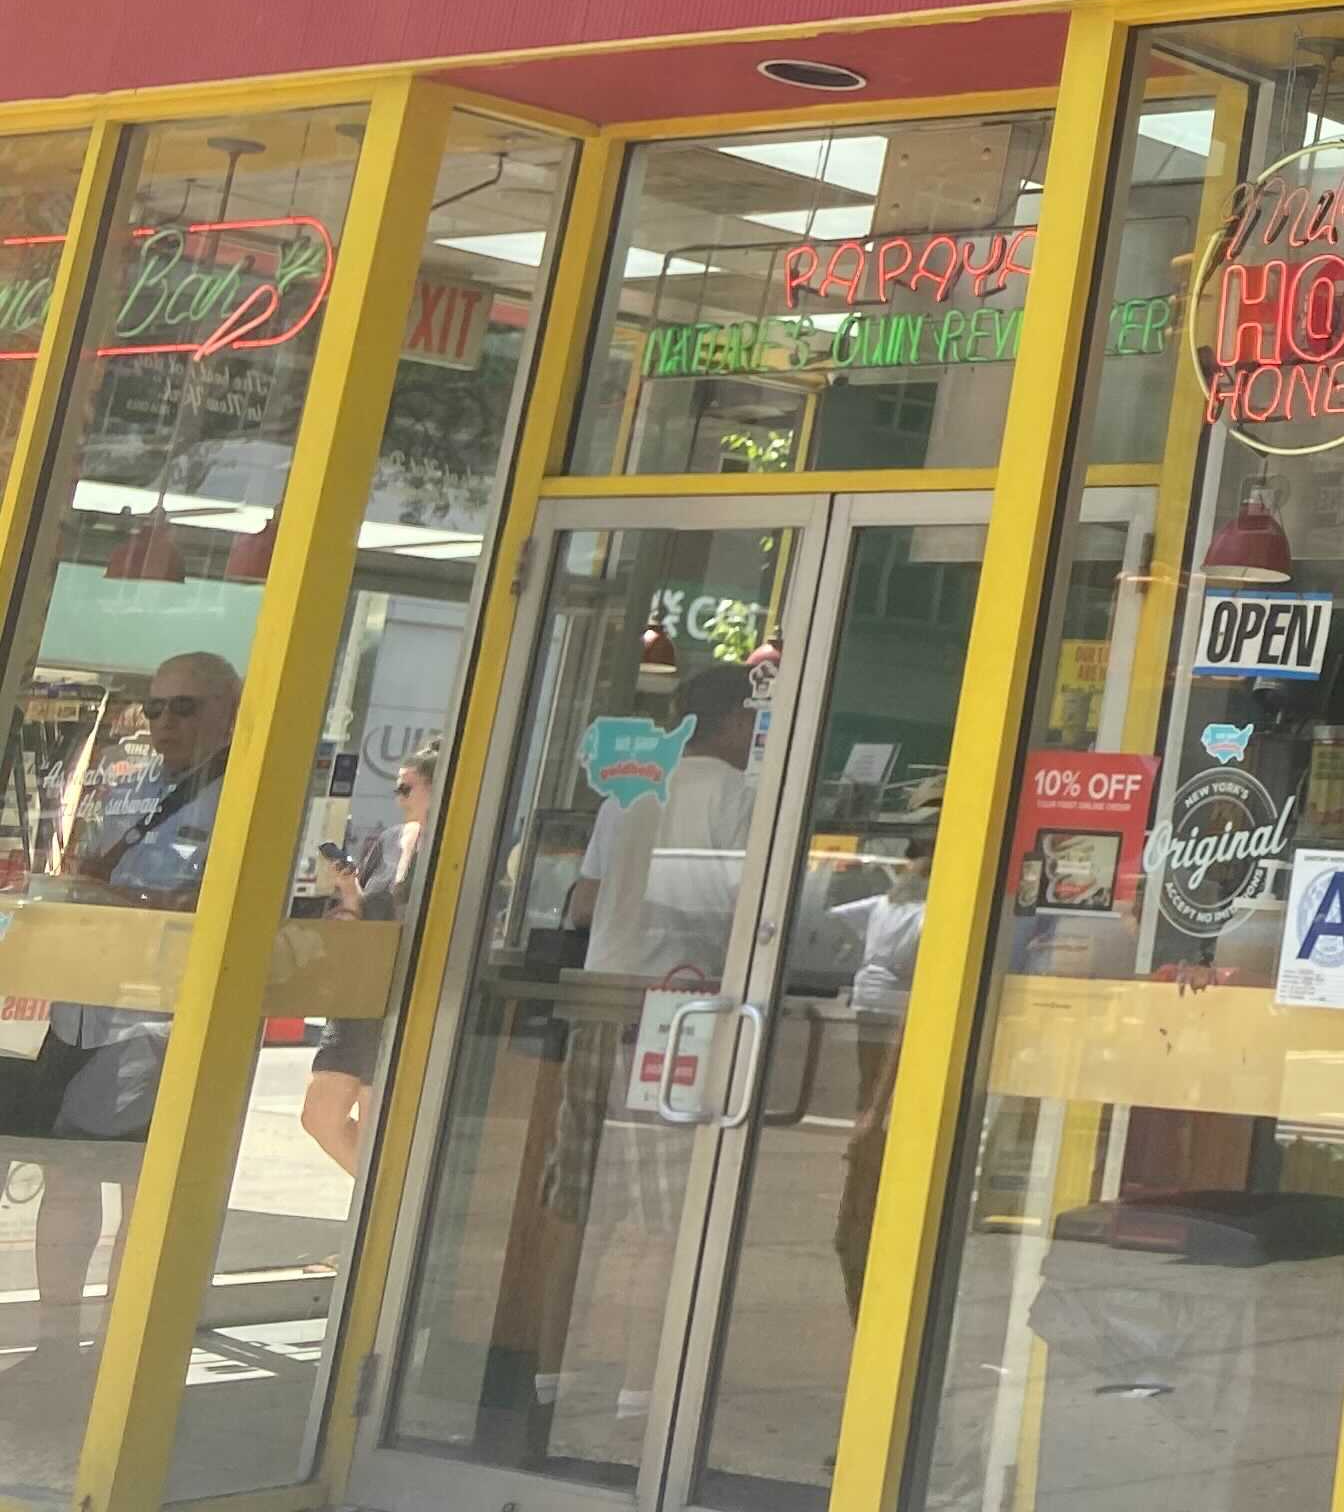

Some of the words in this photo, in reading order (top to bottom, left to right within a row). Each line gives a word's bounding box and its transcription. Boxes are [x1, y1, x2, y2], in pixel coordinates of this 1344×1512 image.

[408, 286, 483, 359] XIT
[831, 313, 929, 368] OWN
[1206, 600, 1324, 669] OPEN
[1035, 769, 1081, 798] 10%
[1088, 772, 1144, 801] OFF
[1184, 784, 1210, 808] NEW
[1211, 781, 1250, 802] YORK'S
[1143, 794, 1297, 890] Original
[1165, 880, 1196, 919] ACCEPT
